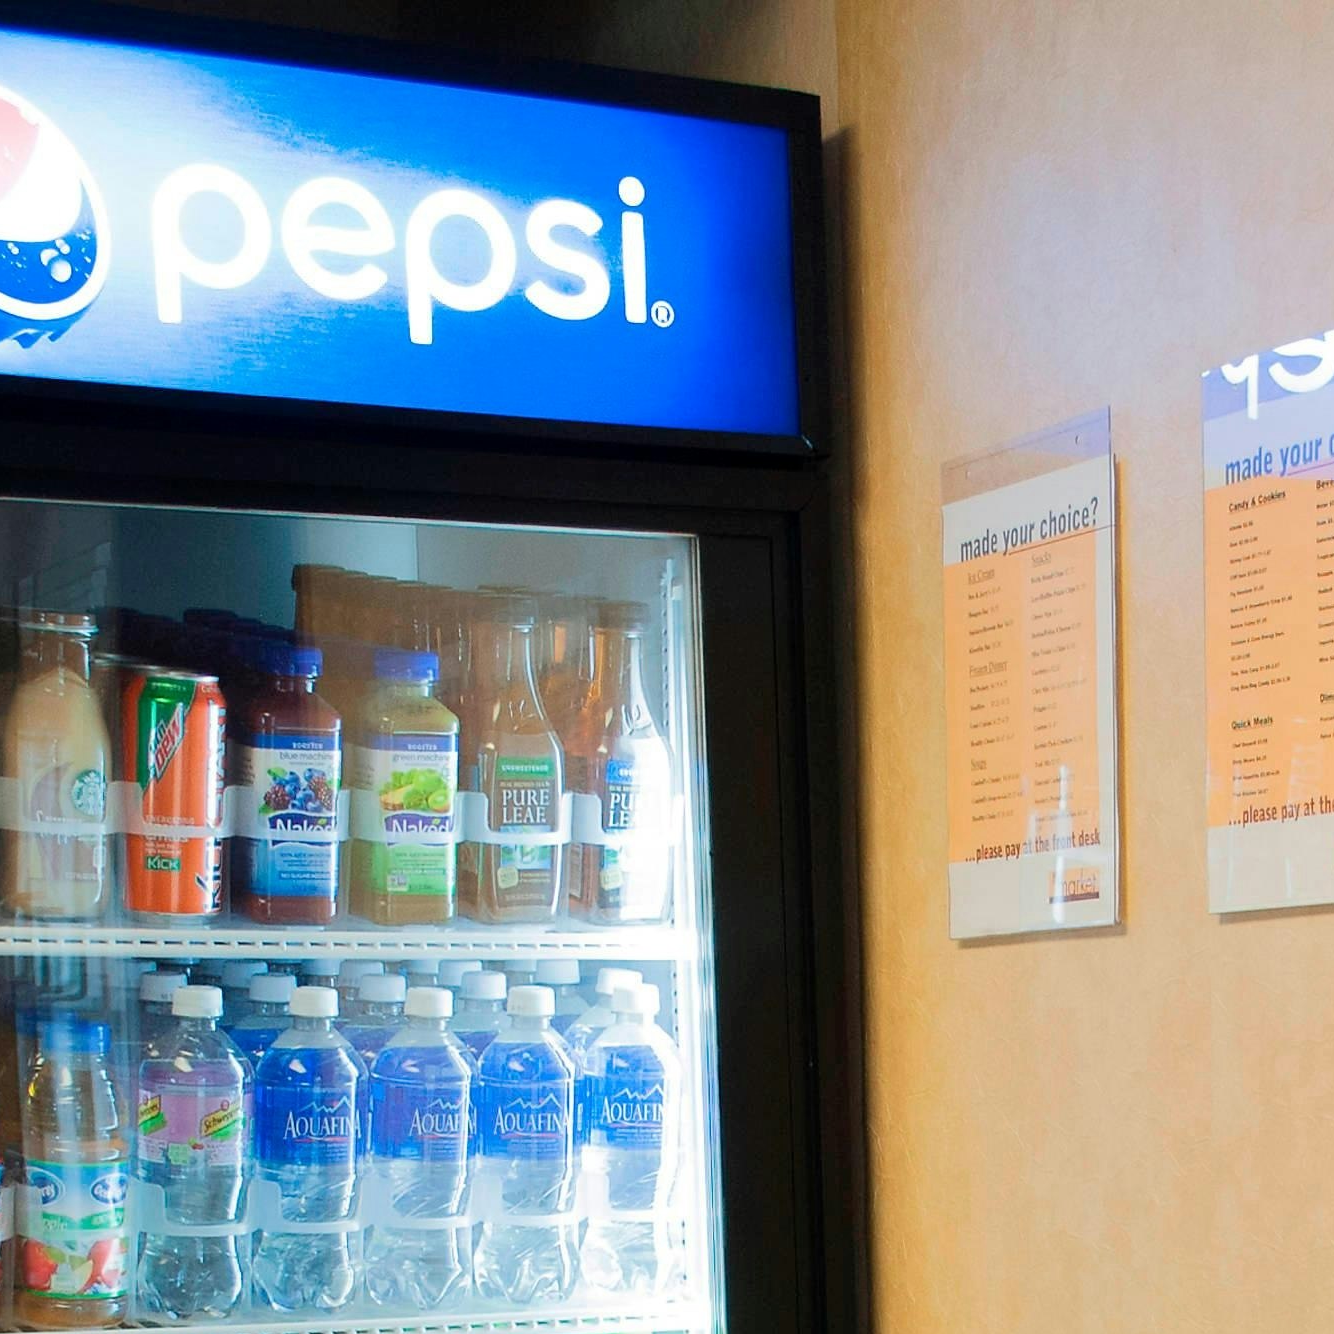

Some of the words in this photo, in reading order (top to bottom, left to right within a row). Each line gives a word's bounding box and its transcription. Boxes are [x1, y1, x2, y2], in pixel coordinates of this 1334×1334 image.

[150, 164, 649, 346] pepsi
[1225, 446, 1273, 486] made
[1279, 437, 1322, 477] your
[1228, 499, 1249, 514] Candy
[1257, 490, 1286, 505] Cookies
[960, 530, 998, 563] made
[1002, 520, 1036, 557] your
[1040, 496, 1099, 542] choice?
[1231, 718, 1251, 730] Quick
[1253, 715, 1273, 727] Meals
[279, 751, 299, 760] blue
[392, 754, 416, 764] green
[501, 788, 550, 807] PURE
[1281, 803, 1300, 823] pay
[1304, 798, 1316, 817] at
[1005, 842, 1021, 861] pay
[1035, 835, 1050, 853] the
[1053, 831, 1075, 851] front
[1078, 828, 1100, 847] desk
[147, 856, 181, 870] KICK
